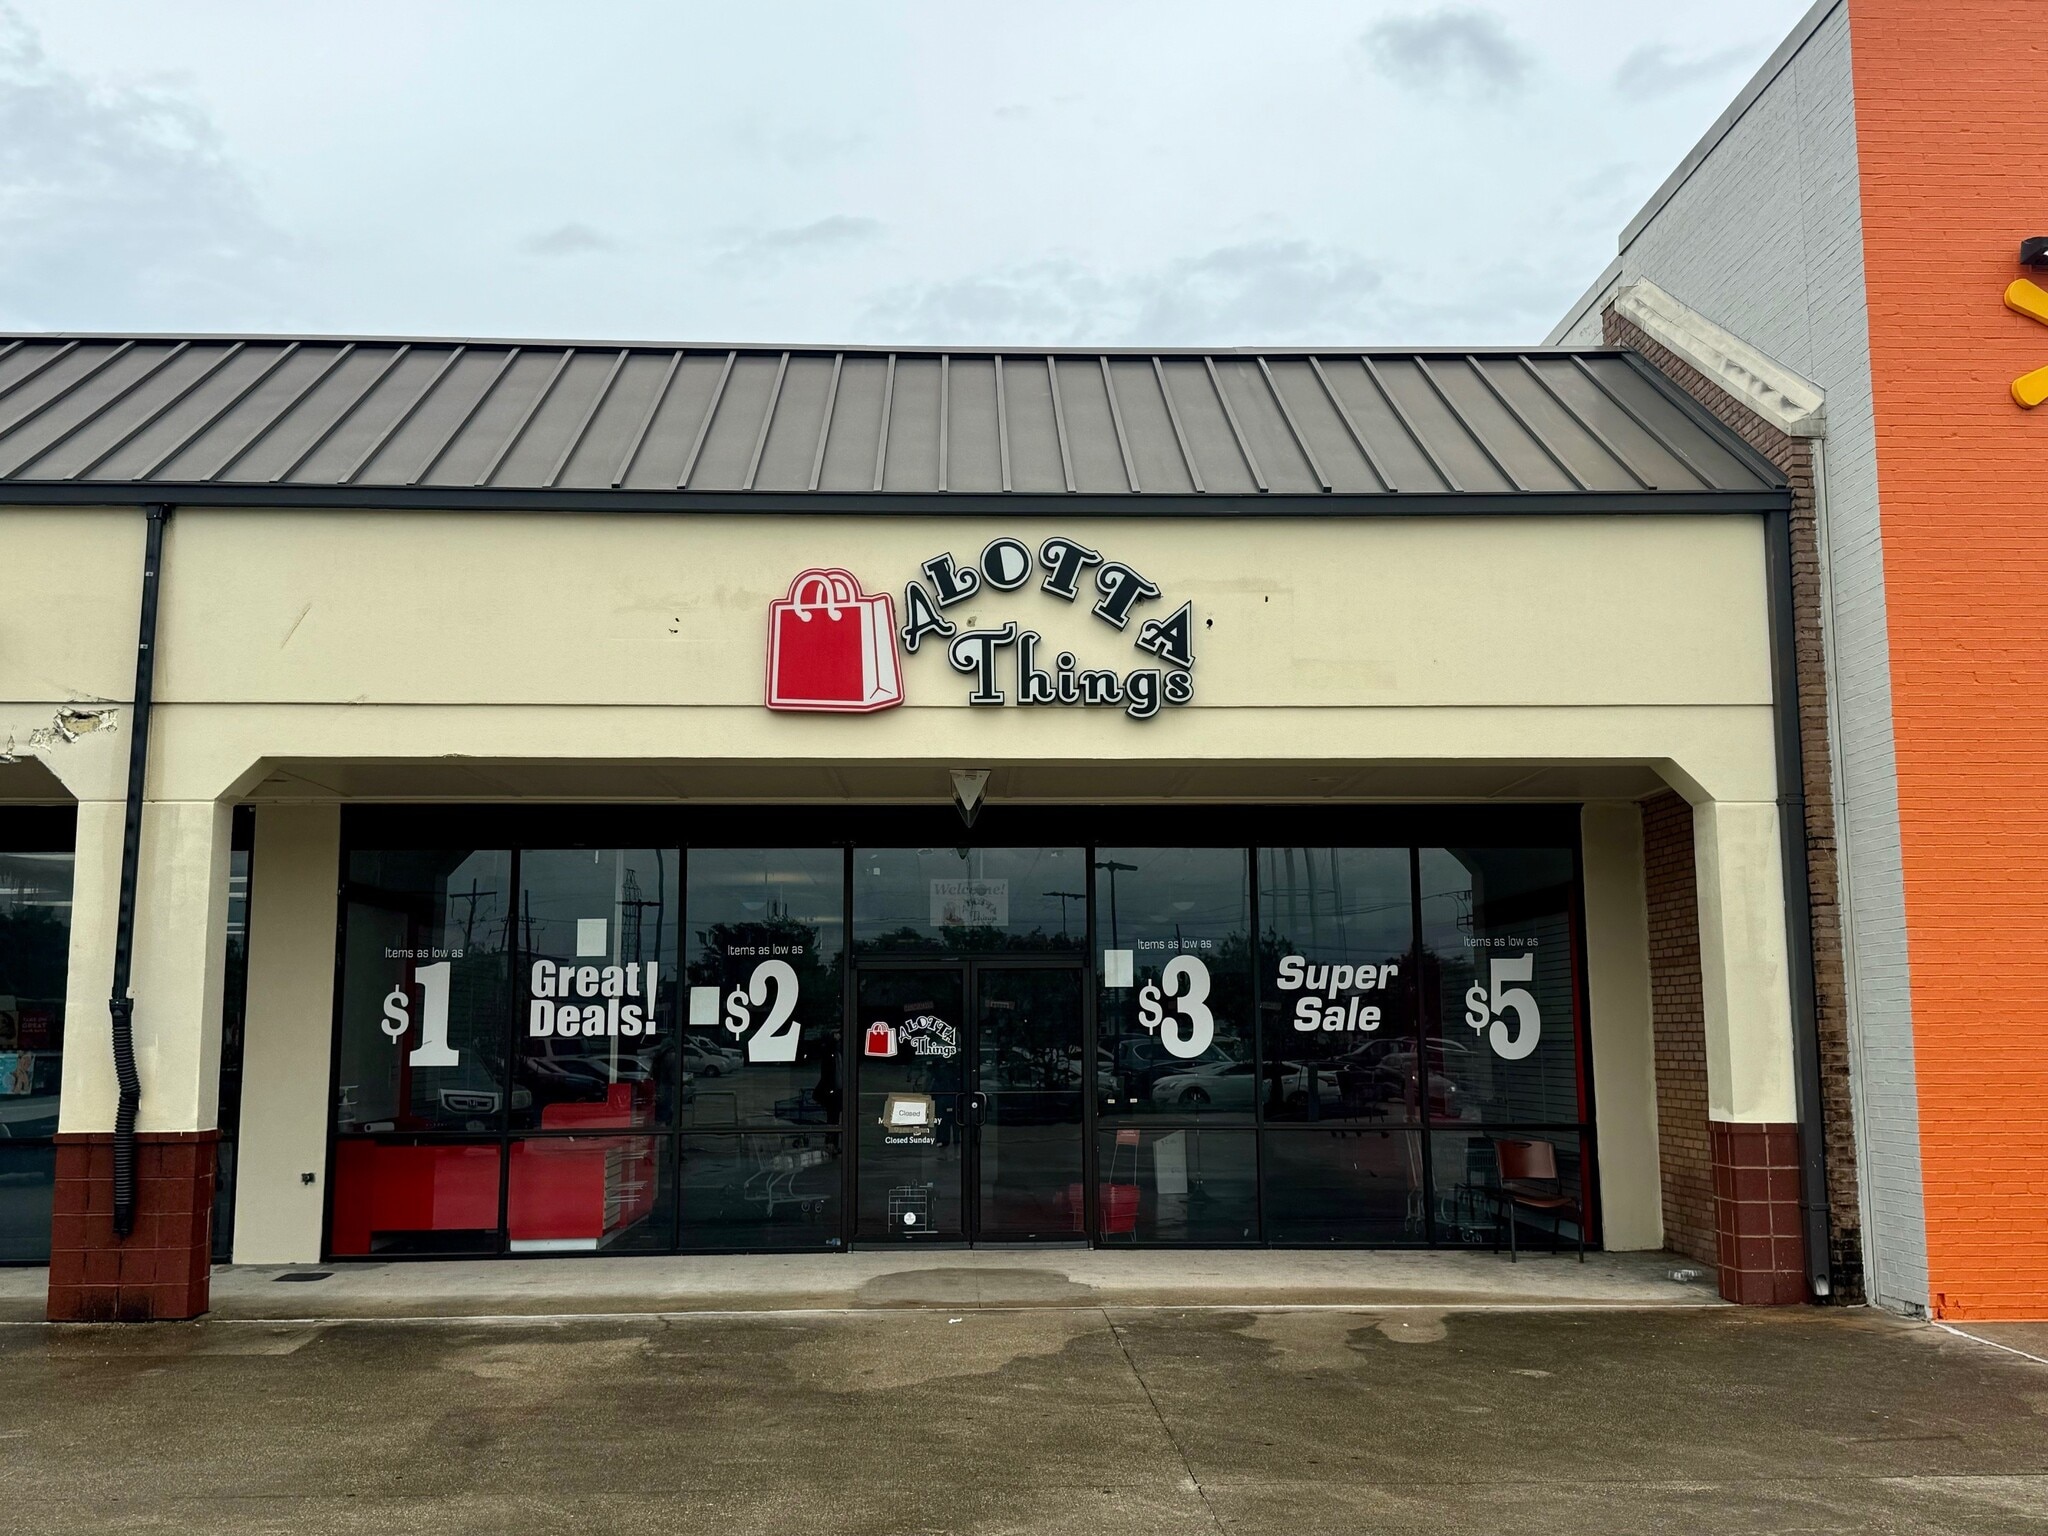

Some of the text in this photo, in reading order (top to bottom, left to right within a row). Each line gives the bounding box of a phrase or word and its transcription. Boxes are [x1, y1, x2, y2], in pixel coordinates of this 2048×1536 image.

[902, 536, 1196, 669] ALOTTA
[948, 621, 1194, 720] Things
[385, 946, 464, 958] Items as low as
[727, 943, 803, 956] Items as low as
[1137, 937, 1212, 950] Items as low as
[1463, 935, 1539, 947] Items as low as
[531, 960, 641, 997] Great
[1277, 956, 1399, 999] Super
[382, 962, 459, 1067] $1
[725, 960, 801, 1062] $2
[1138, 955, 1214, 1058] $3
[1293, 996, 1381, 1031] Sale
[1465, 953, 1541, 1060] $5
[899, 1015, 956, 1046] ALOTTA
[911, 1035, 957, 1058] Things
[899, 1109, 920, 1117] Closed
[885, 1136, 935, 1145] Closed Sunday
